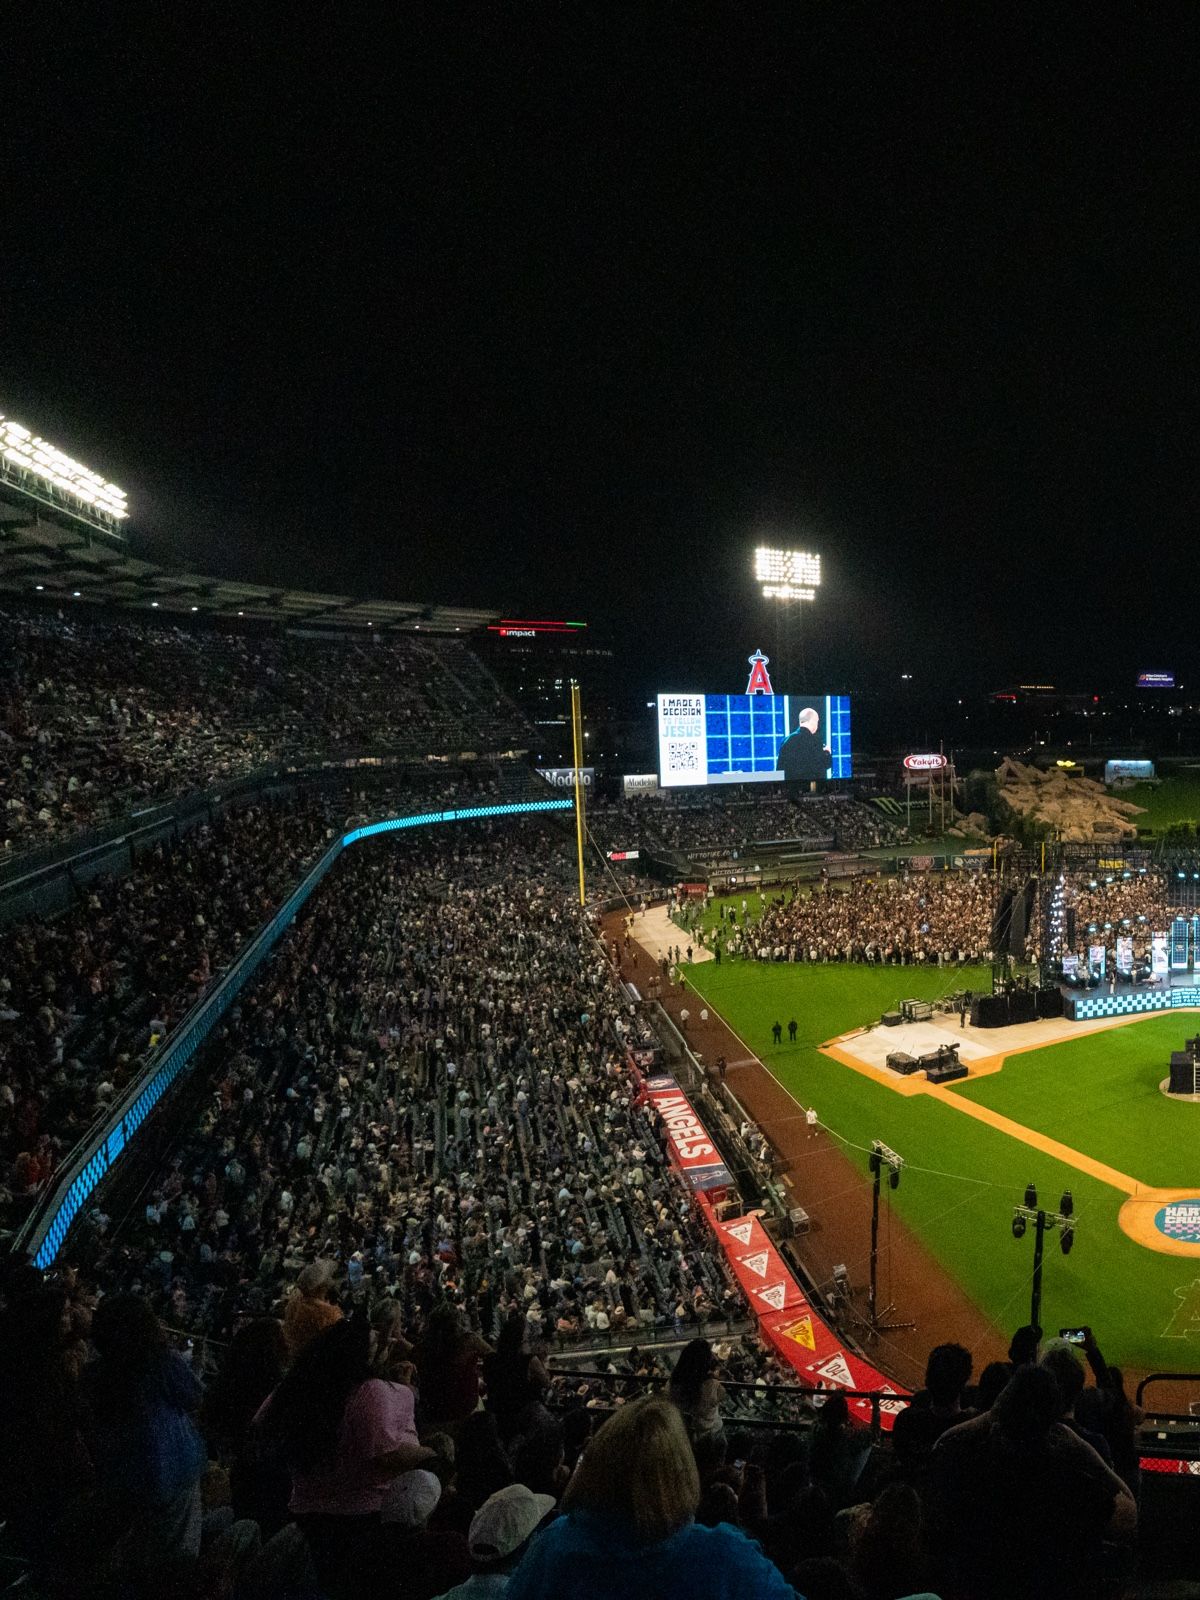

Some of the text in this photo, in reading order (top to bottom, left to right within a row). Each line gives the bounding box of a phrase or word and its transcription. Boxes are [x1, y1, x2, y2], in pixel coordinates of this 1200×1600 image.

[506, 629, 536, 638] impact
[668, 699, 692, 707] MADE
[696, 699, 702, 707] A
[664, 708, 702, 716] DECISION
[663, 726, 702, 738] JESUS
[545, 771, 592, 787] Modelo
[654, 1096, 714, 1159] ANGELS
